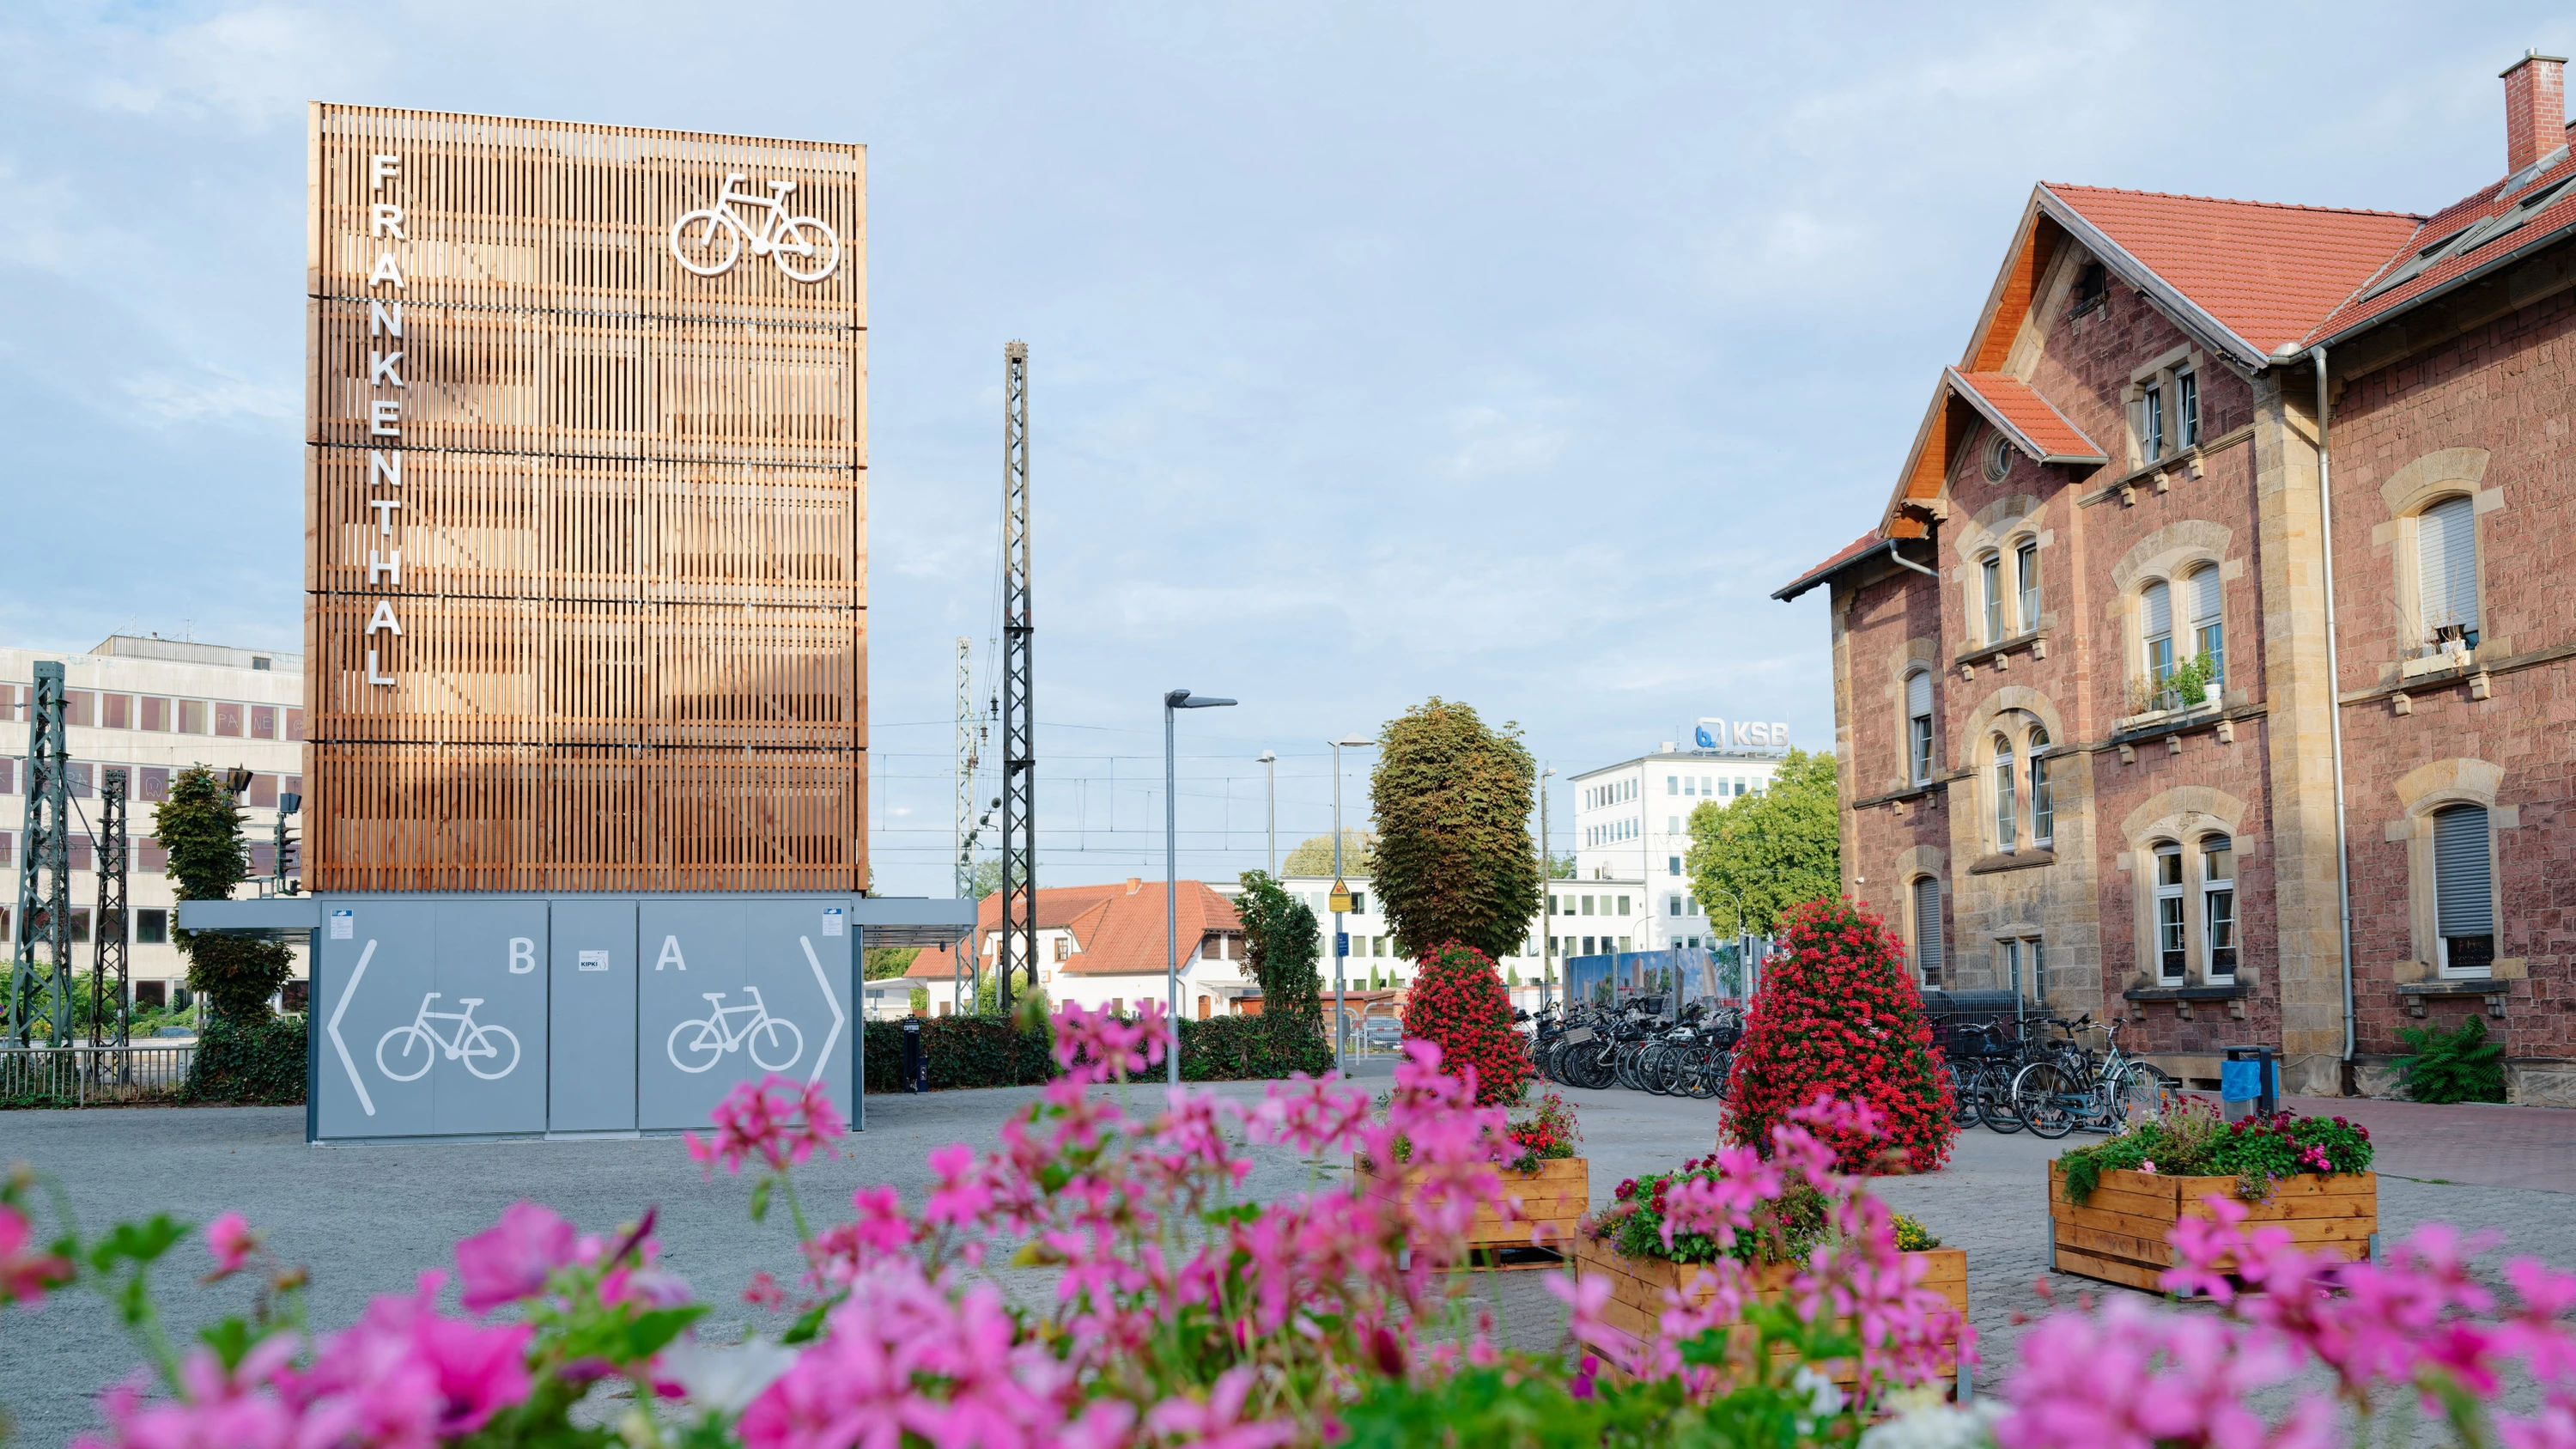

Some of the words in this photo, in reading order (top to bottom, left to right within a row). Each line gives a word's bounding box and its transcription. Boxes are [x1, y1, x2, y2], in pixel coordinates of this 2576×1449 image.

[366, 154, 406, 687] FRANKENTHAL
[1733, 721, 1789, 746] KSB
[508, 937, 536, 975] B
[655, 934, 687, 971] A
